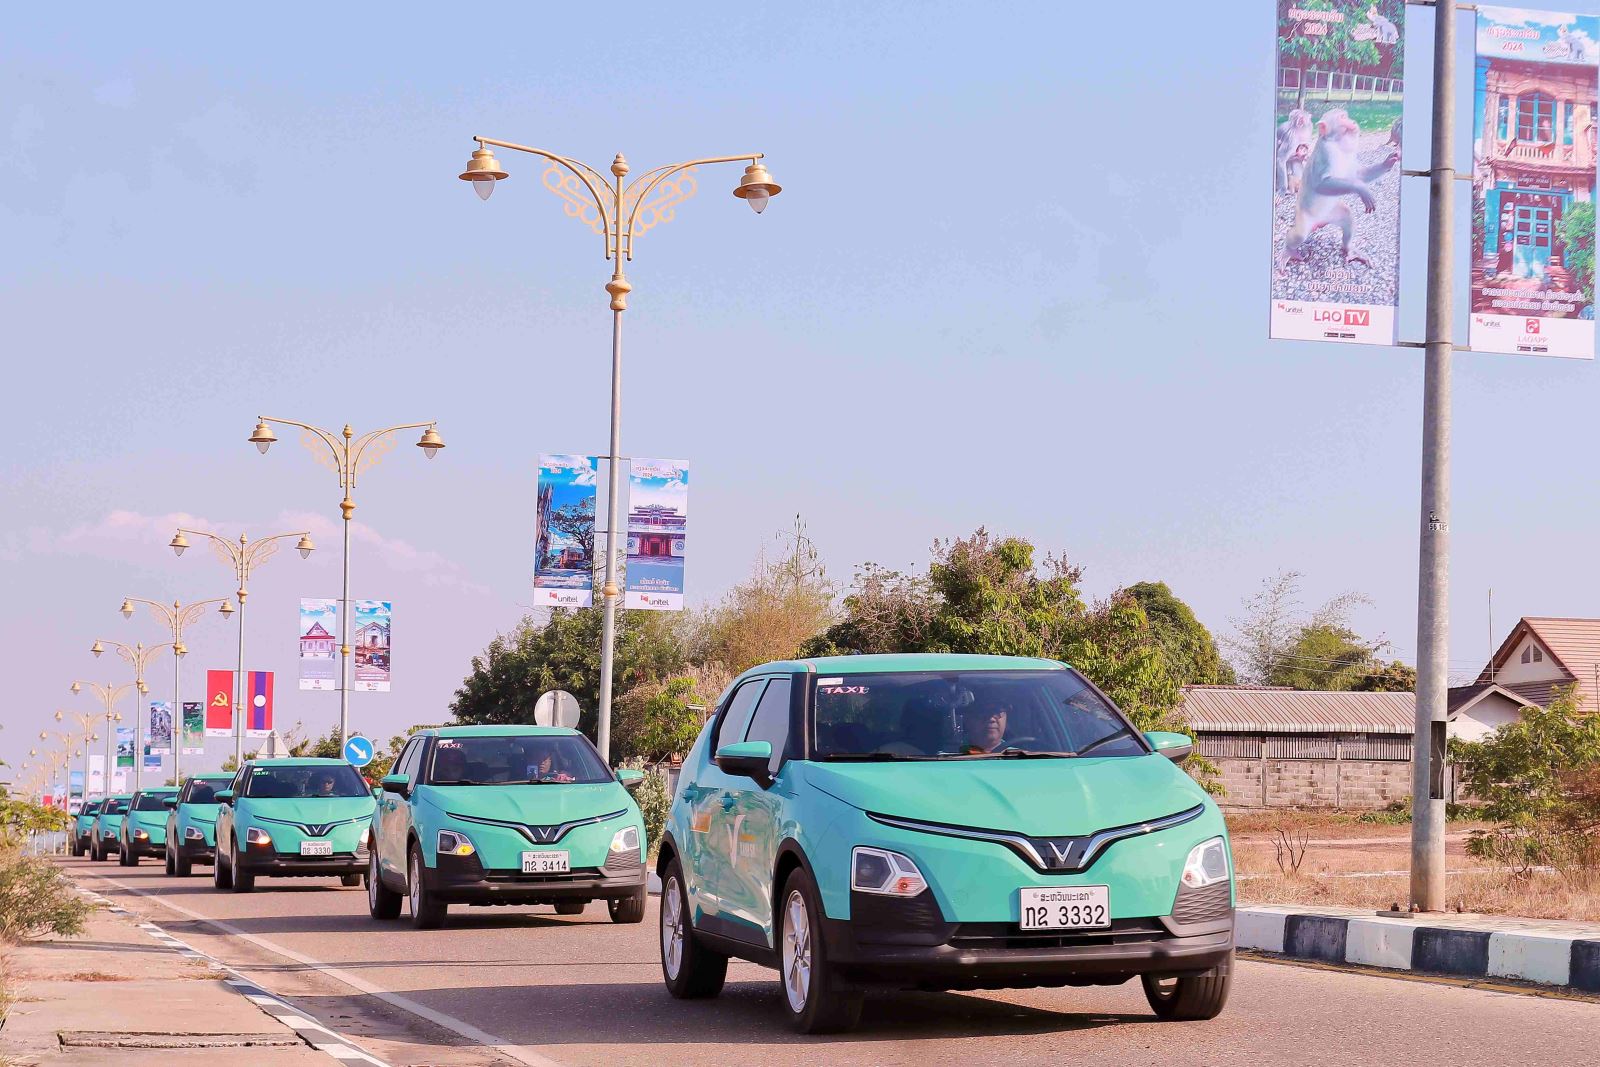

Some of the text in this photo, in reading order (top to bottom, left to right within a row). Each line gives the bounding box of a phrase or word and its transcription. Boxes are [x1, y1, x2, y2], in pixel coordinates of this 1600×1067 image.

[1304, 22, 1328, 35] 2024
[1313, 310, 1368, 325] LAO TV
[557, 595, 578, 603] unitel
[648, 598, 669, 606] unitel
[825, 686, 865, 694] TAXI
[313, 847, 331, 855] 3330
[542, 860, 567, 871] 3414
[1058, 904, 1105, 926] 3332
